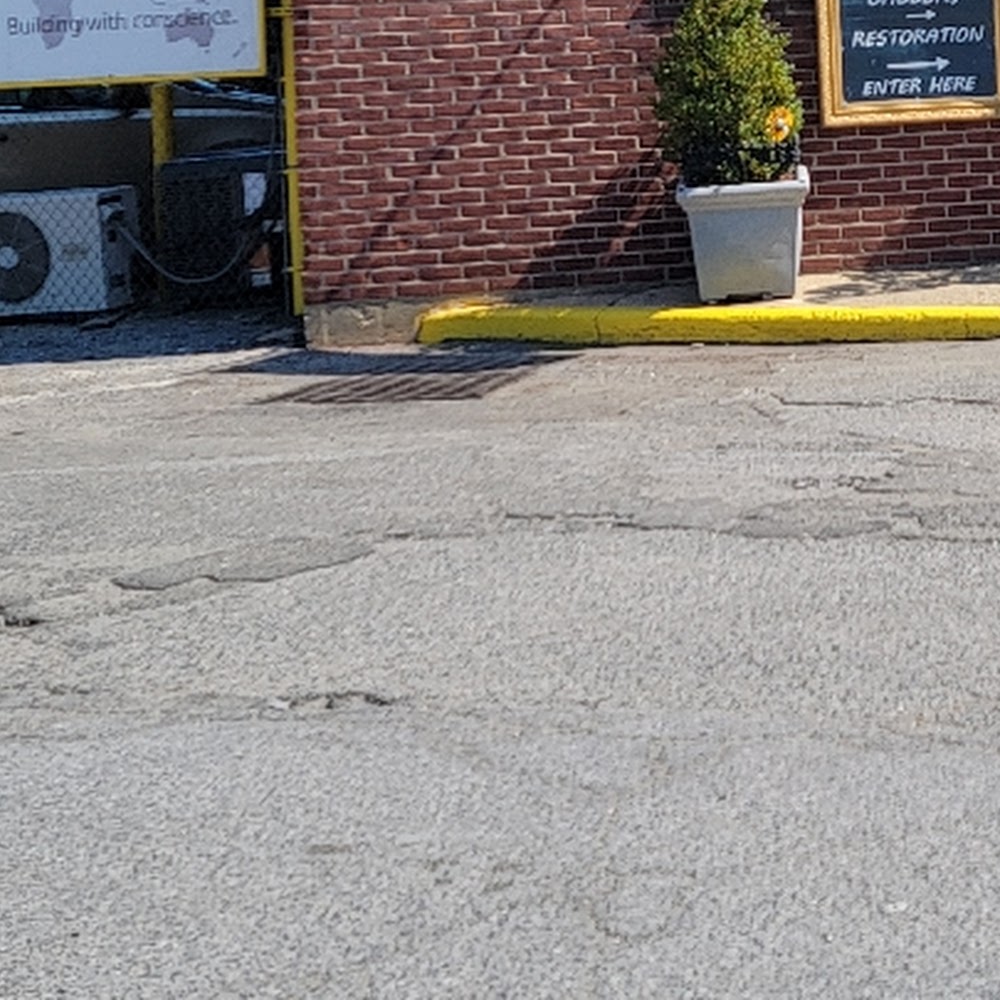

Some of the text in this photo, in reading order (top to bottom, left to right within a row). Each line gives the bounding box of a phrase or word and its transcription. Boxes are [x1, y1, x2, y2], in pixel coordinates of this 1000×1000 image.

[7, 14, 83, 37] Building
[87, 12, 127, 31] with
[851, 25, 985, 48] RESTORATION
[862, 76, 977, 97] ENTER HERE
